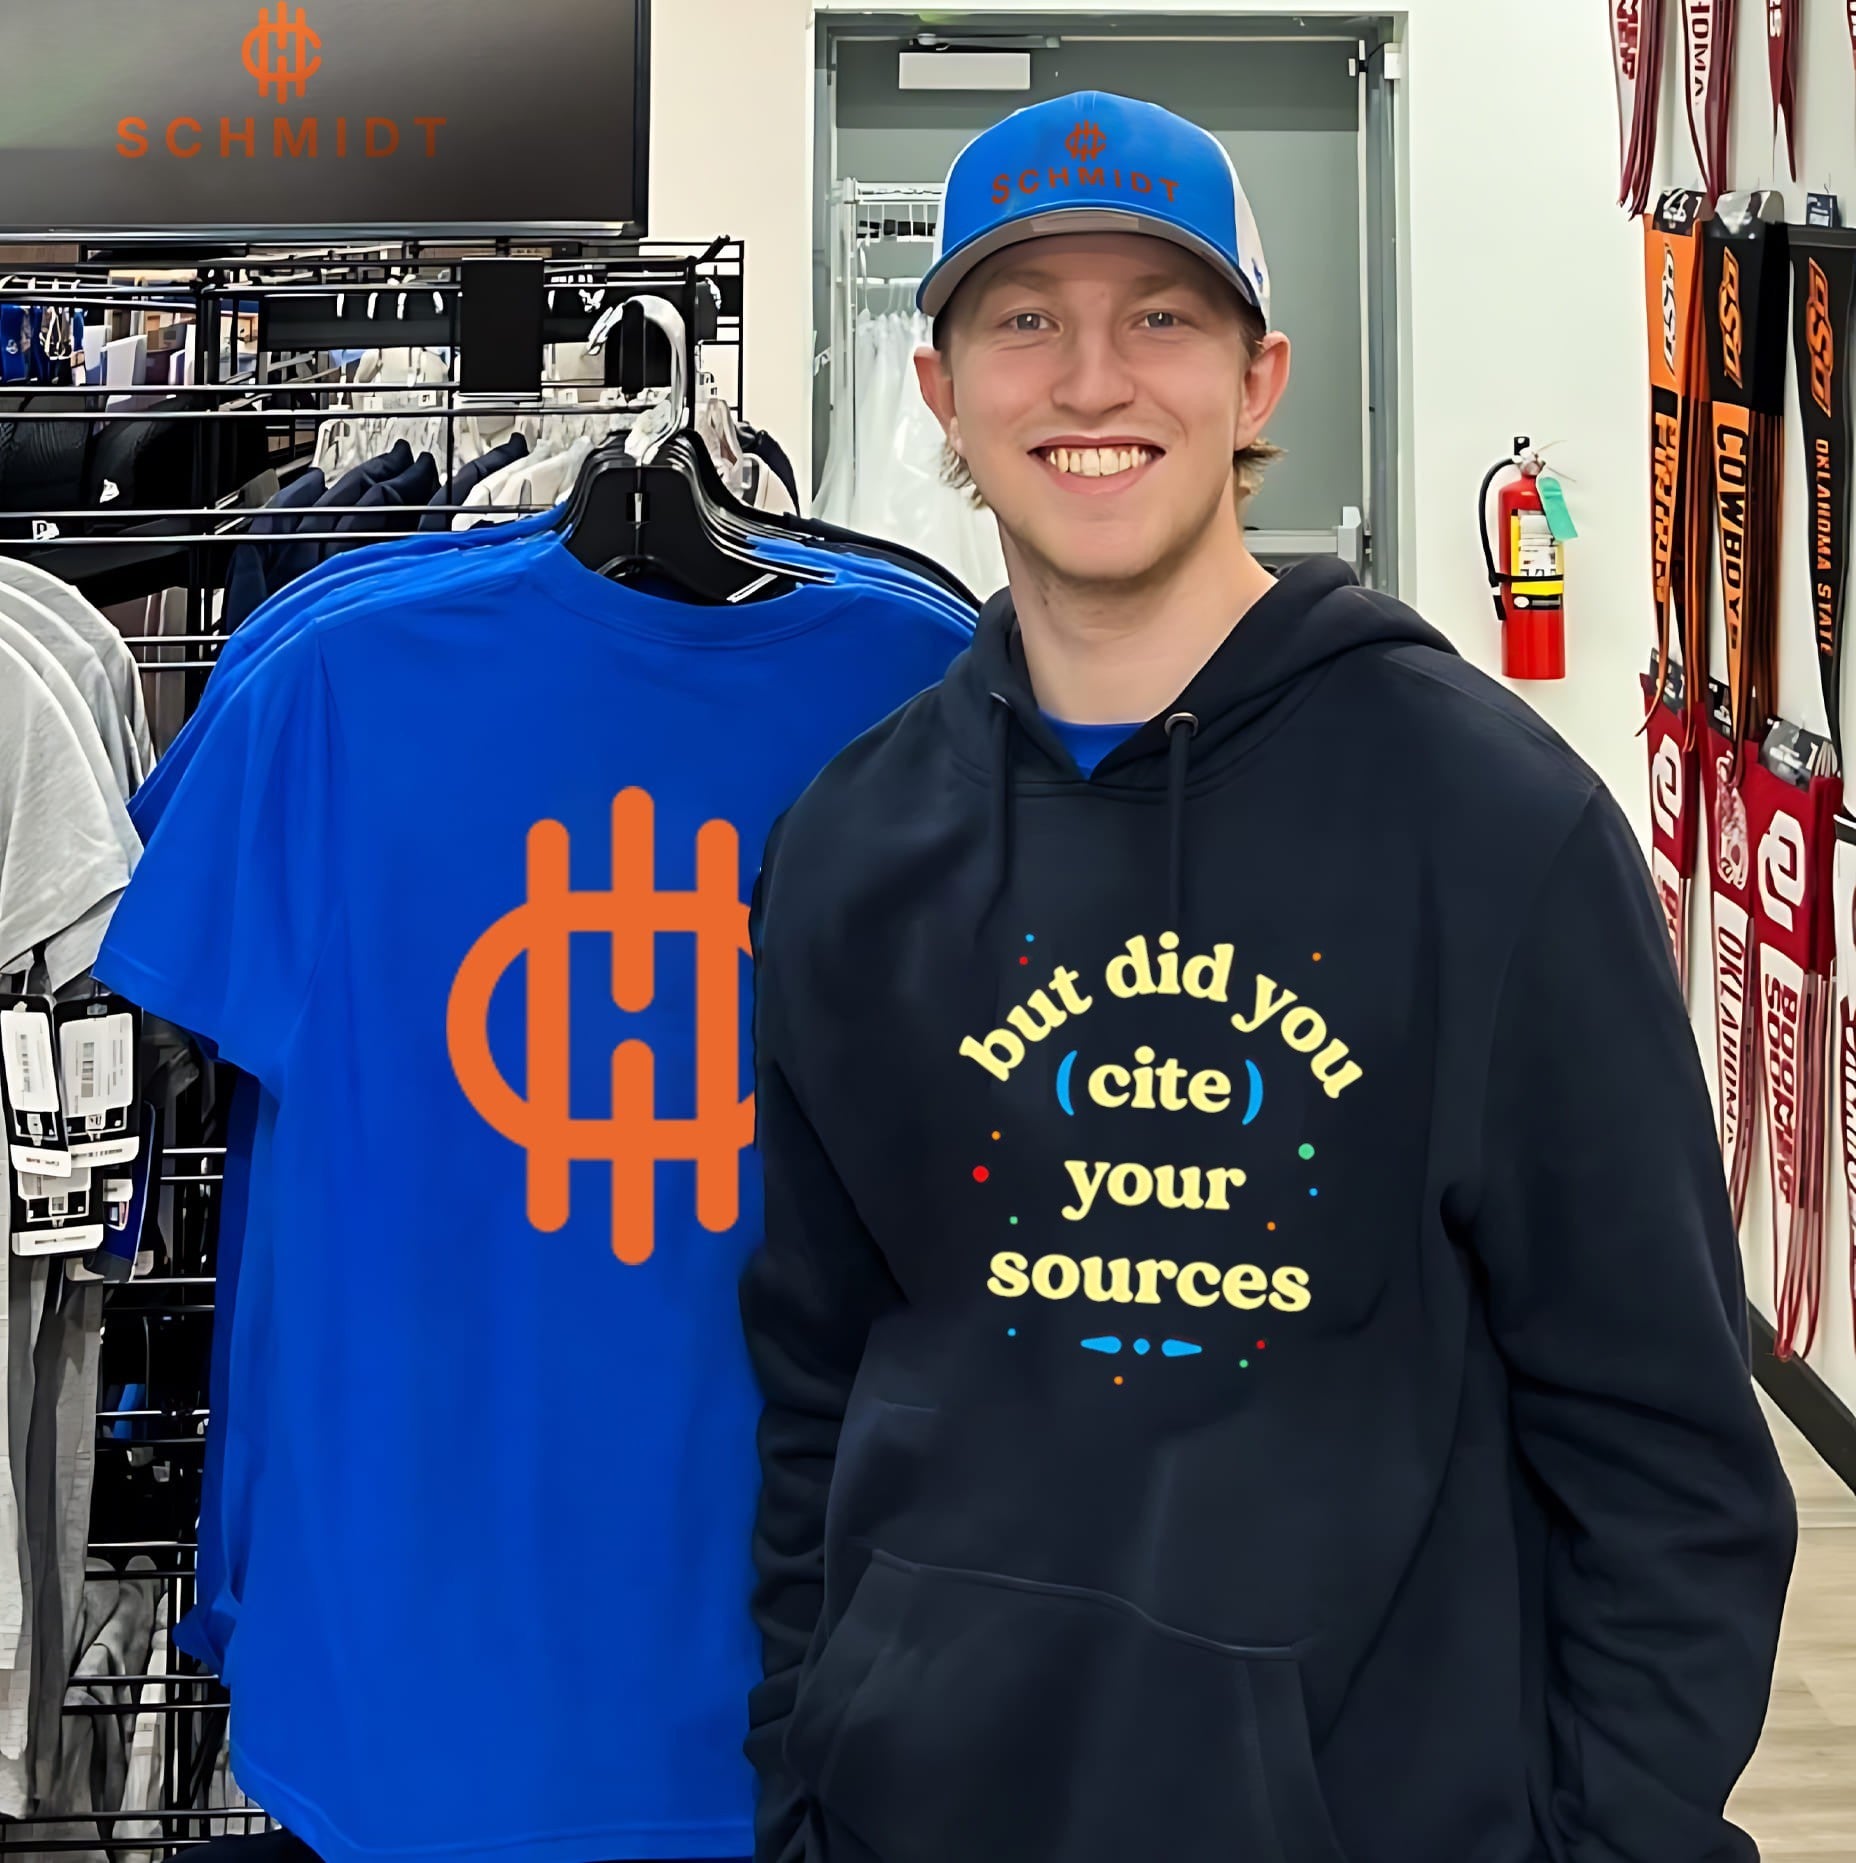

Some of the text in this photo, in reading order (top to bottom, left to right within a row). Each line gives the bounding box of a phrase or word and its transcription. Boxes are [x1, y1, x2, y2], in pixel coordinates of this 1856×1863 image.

[116, 116, 447, 159] SCHMIDT
[991, 167, 1179, 205] SCHMIDT
[1815, 438, 1832, 570] OKLAHOMA
[960, 931, 1363, 1098] but did you
[1062, 1160, 1247, 1221] your
[987, 1251, 1312, 1312] sources
